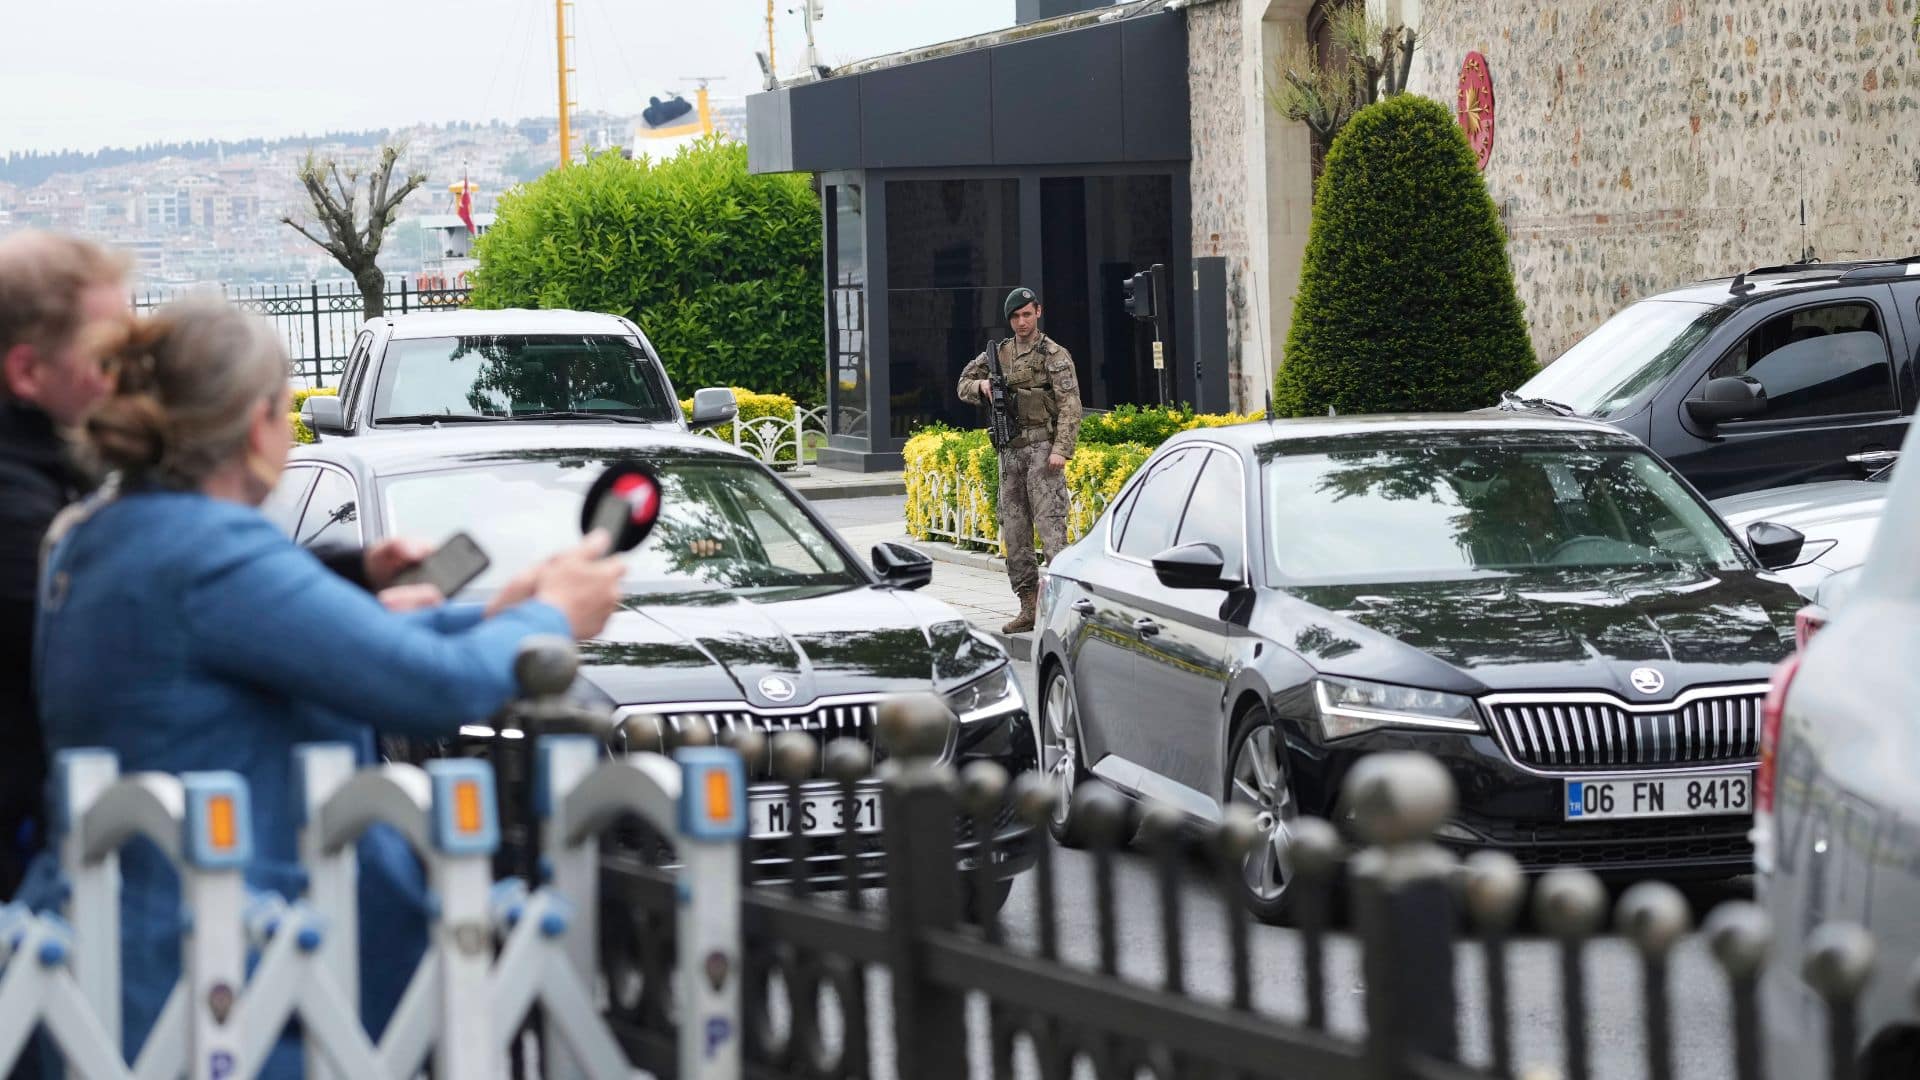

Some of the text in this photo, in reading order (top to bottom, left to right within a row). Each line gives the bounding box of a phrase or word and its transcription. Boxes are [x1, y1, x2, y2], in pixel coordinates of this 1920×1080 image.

[1569, 802, 1581, 812] TR
[1583, 779, 1746, 814] 06 FN 8413
[832, 798, 875, 829] 321
